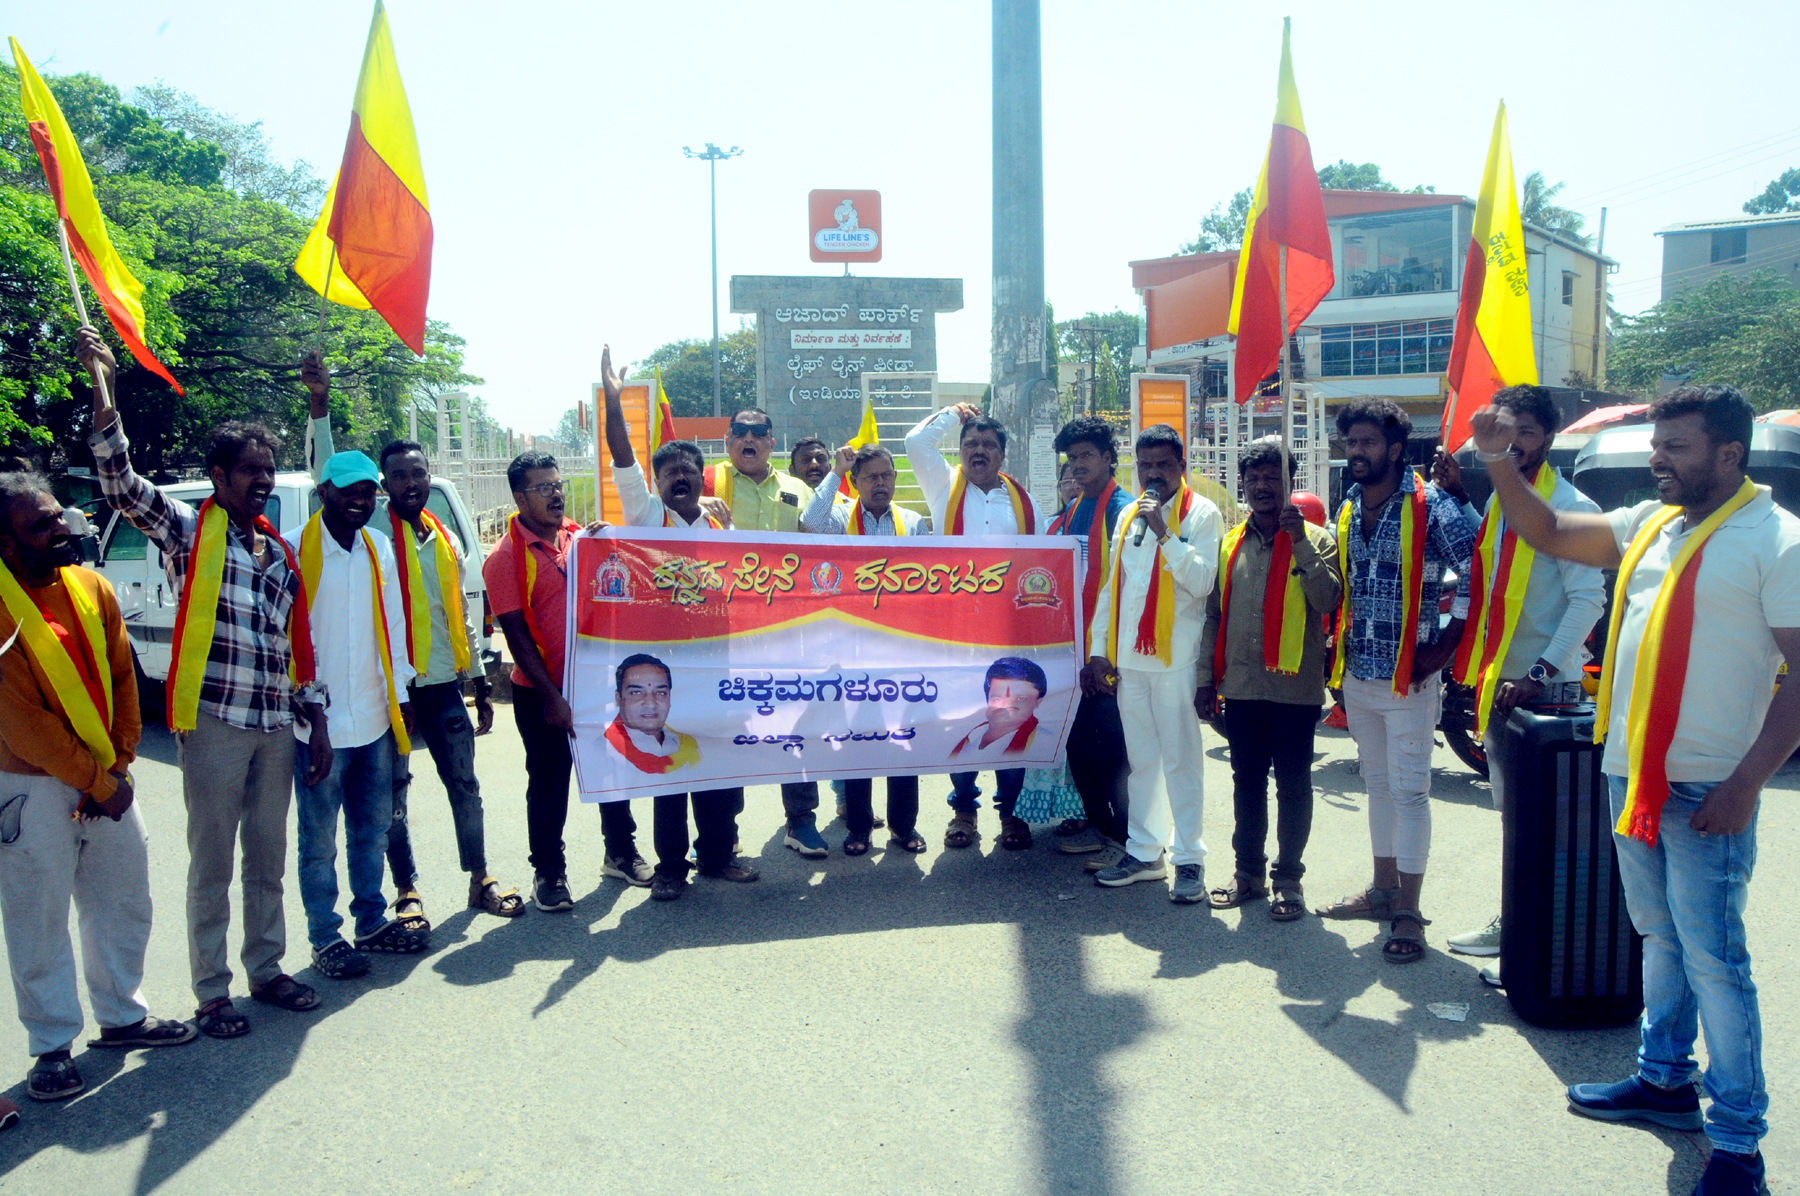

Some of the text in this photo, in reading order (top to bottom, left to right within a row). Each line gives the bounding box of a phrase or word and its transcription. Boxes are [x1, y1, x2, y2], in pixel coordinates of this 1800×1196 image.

[823, 233, 870, 242] LIFE LINE'S
[1485, 231, 1521, 268] ಕನ್ನಡ
[775, 303, 924, 323] ಆಜಾದ್ ಪಾರ್ಕ್
[794, 333, 834, 344] ನಿರ್ಮಾಣ
[837, 333, 861, 347] ಮತ್ತು
[787, 354, 825, 379] ಲೈಫ್
[831, 354, 867, 379] ಲೈನ್
[653, 552, 1012, 609] ಕನ್ನಡ ಸೇನೆ ಕರ್ನಾಟಕ
[718, 672, 938, 716] ಚಿಕ್ಕಮಗಳೂರು
